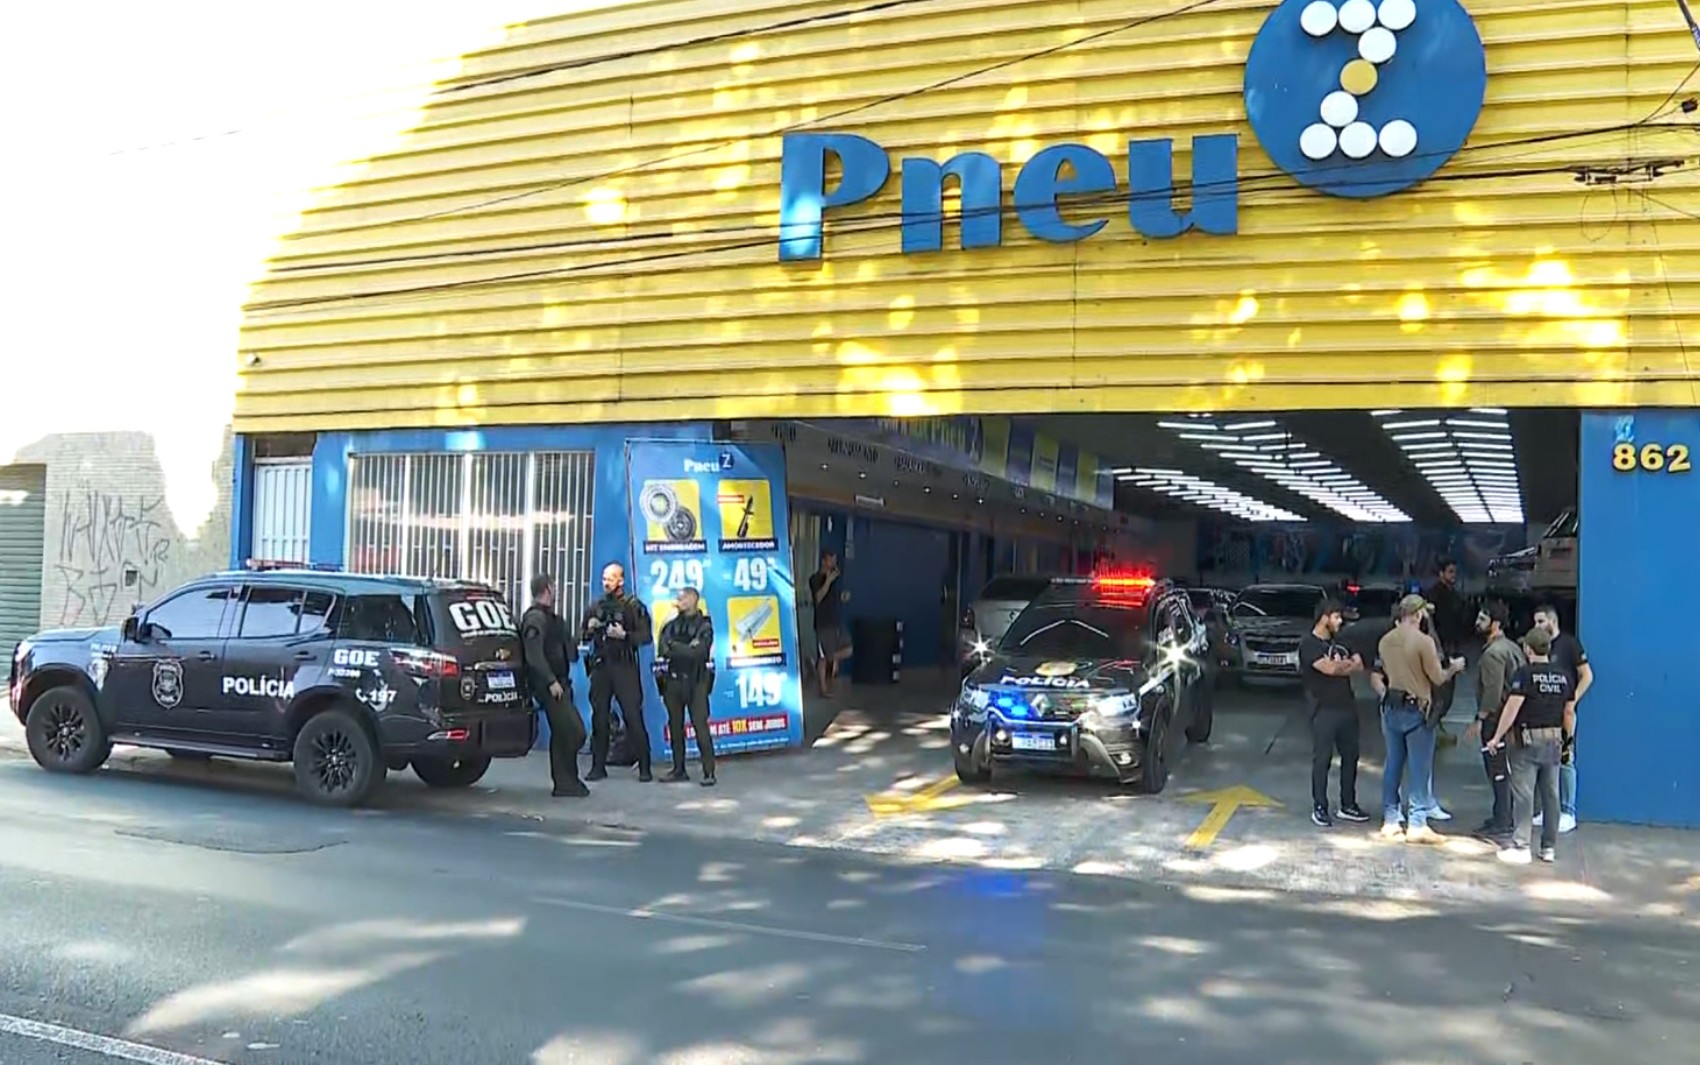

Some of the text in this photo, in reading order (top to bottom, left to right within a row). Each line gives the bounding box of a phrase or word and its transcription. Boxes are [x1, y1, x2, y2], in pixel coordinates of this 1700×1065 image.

[779, 132, 1238, 262] Pneu
[683, 458, 720, 473] Pneu
[1613, 442, 1691, 473] 862
[650, 558, 704, 595] 249
[733, 557, 768, 591] 49
[449, 600, 517, 632] GOE
[333, 648, 380, 667] GOE
[223, 674, 295, 699] POLÍCIA
[735, 670, 783, 709] 149
[999, 675, 1091, 689] POLÍCIA
[1532, 671, 1568, 685] POLÍCIA
[1539, 683, 1562, 693] CIVIL
